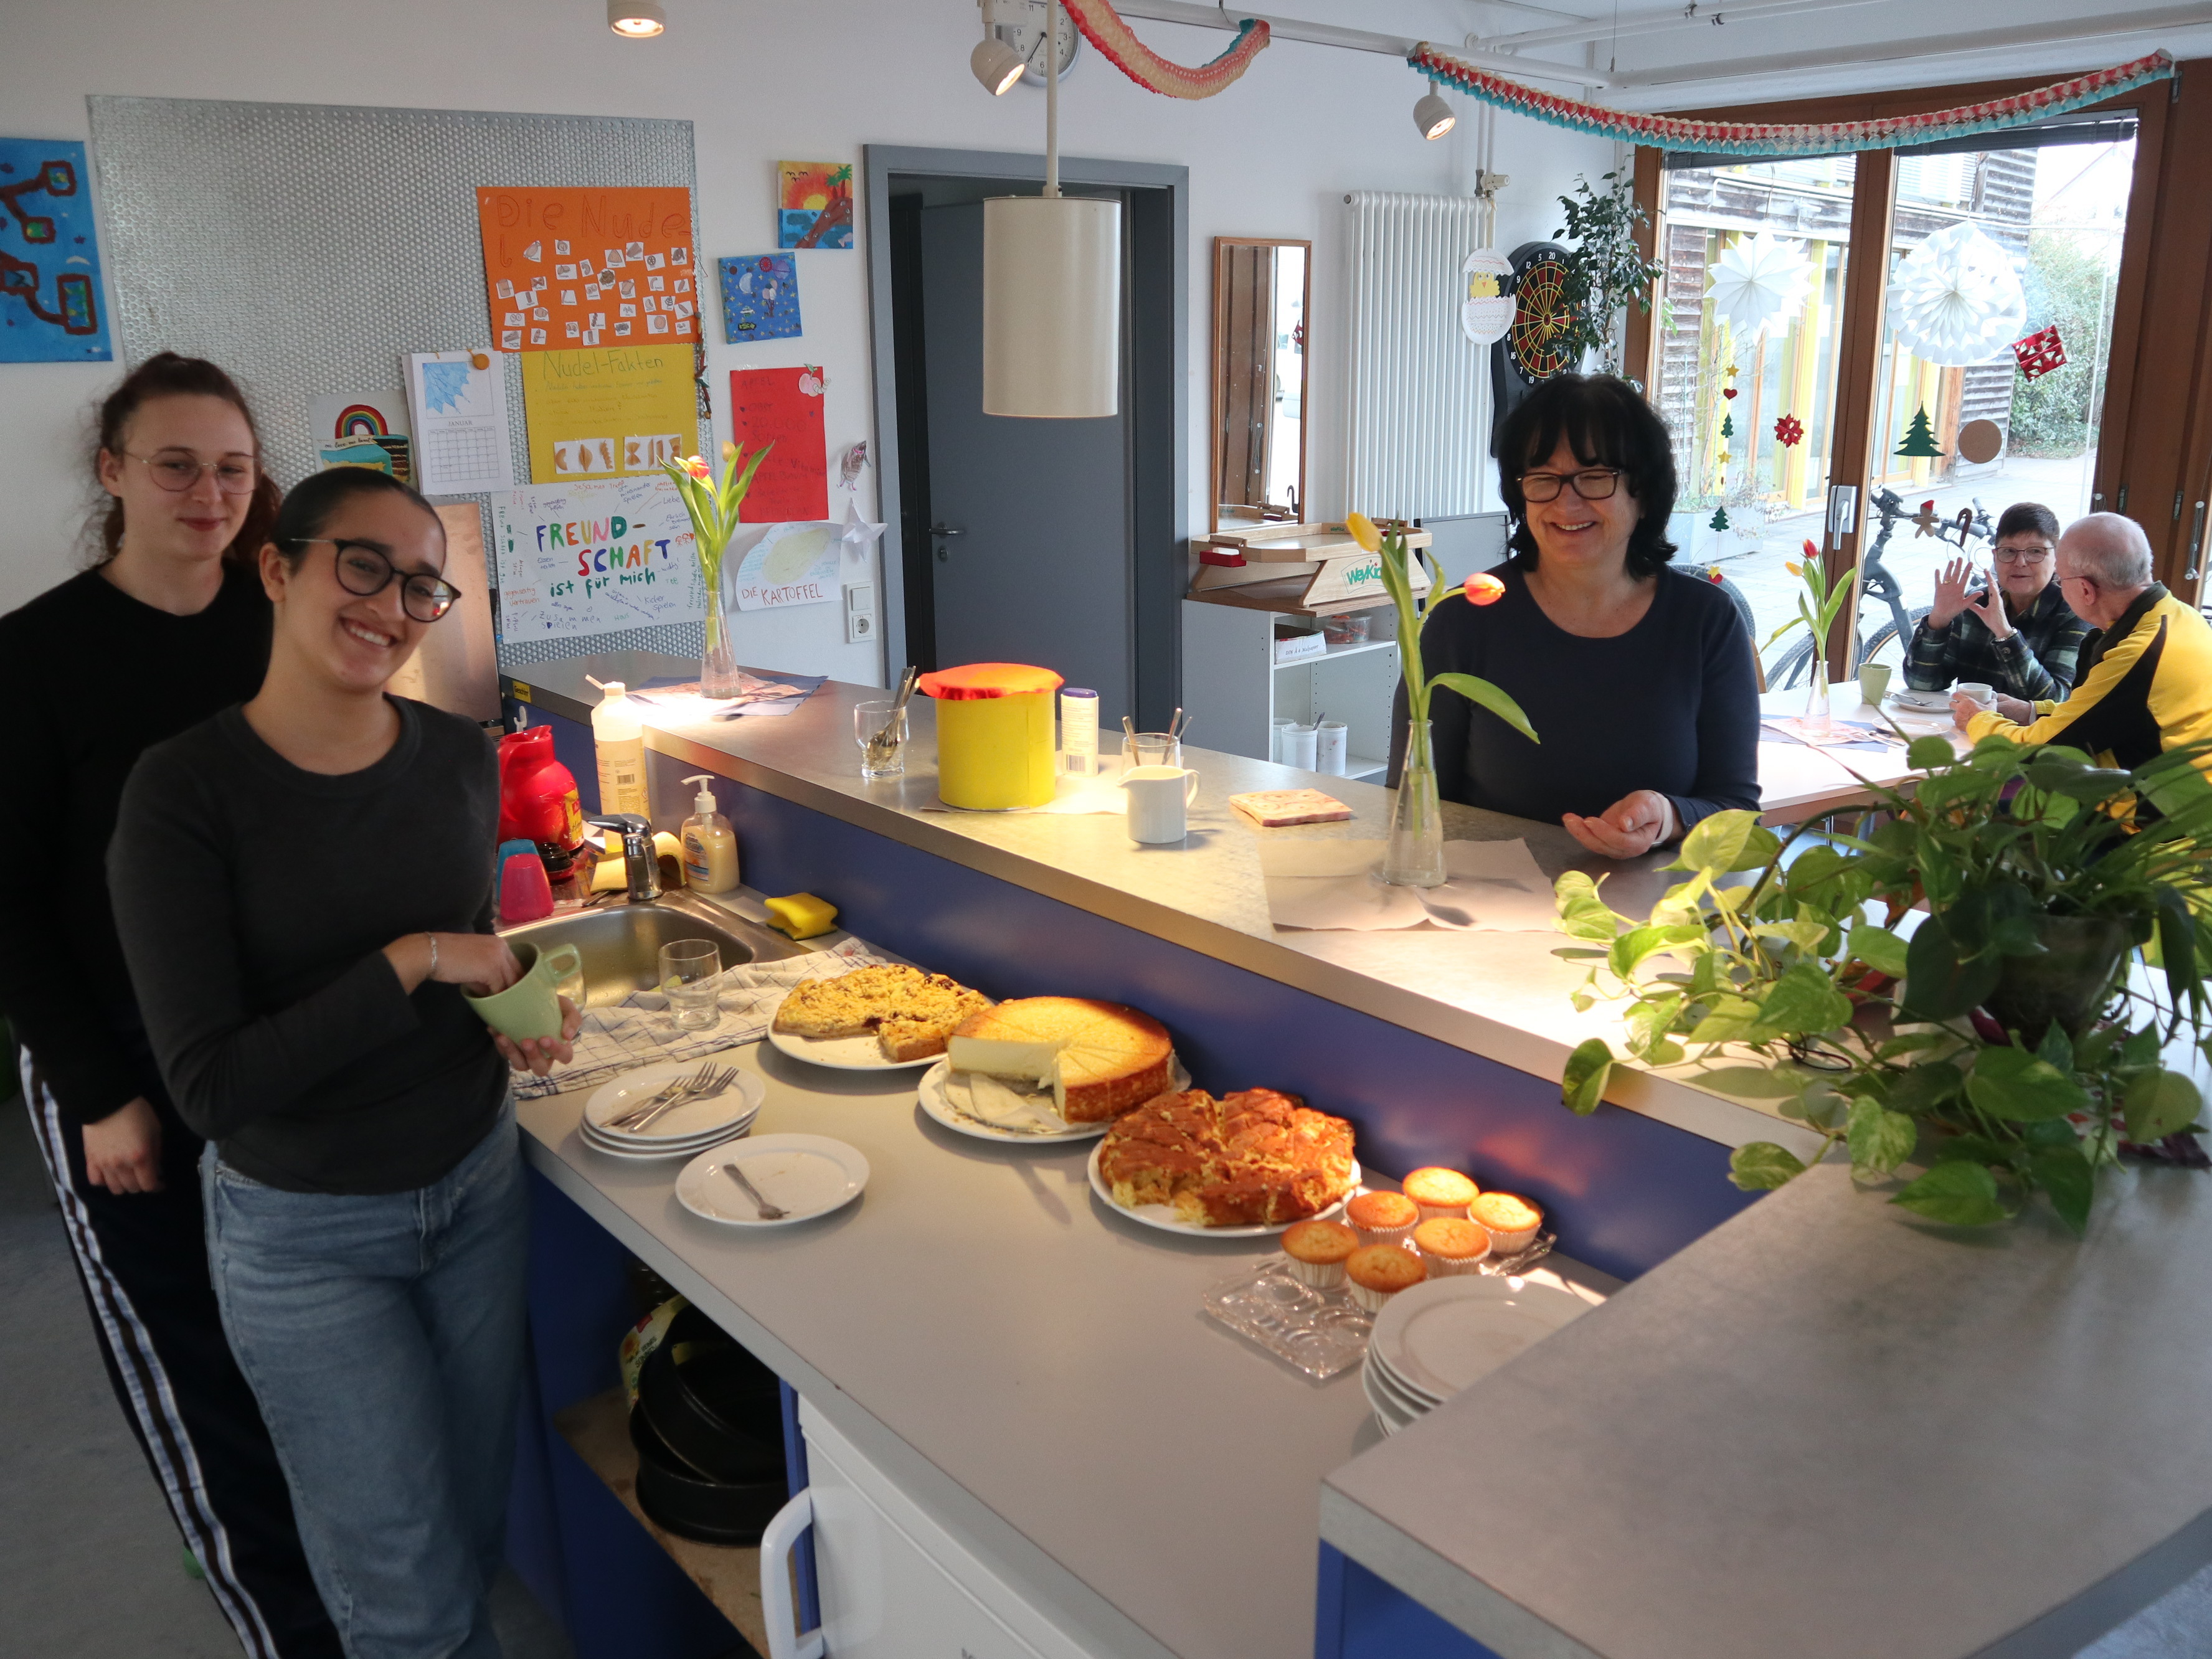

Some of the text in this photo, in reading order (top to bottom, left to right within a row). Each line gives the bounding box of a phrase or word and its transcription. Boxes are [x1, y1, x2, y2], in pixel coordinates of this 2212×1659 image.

[1538, 253, 1542, 262] 5
[1548, 252, 1556, 260] 20
[1516, 275, 1521, 283] 9
[1510, 351, 1516, 359] 16
[1520, 366, 1523, 374] 7
[663, 495, 681, 504] Liebe
[578, 539, 671, 576] SCHAFT
[1346, 562, 1382, 585] WeyKic
[550, 567, 656, 599] ist für mich
[742, 583, 823, 605] DIE KARTOFFEL
